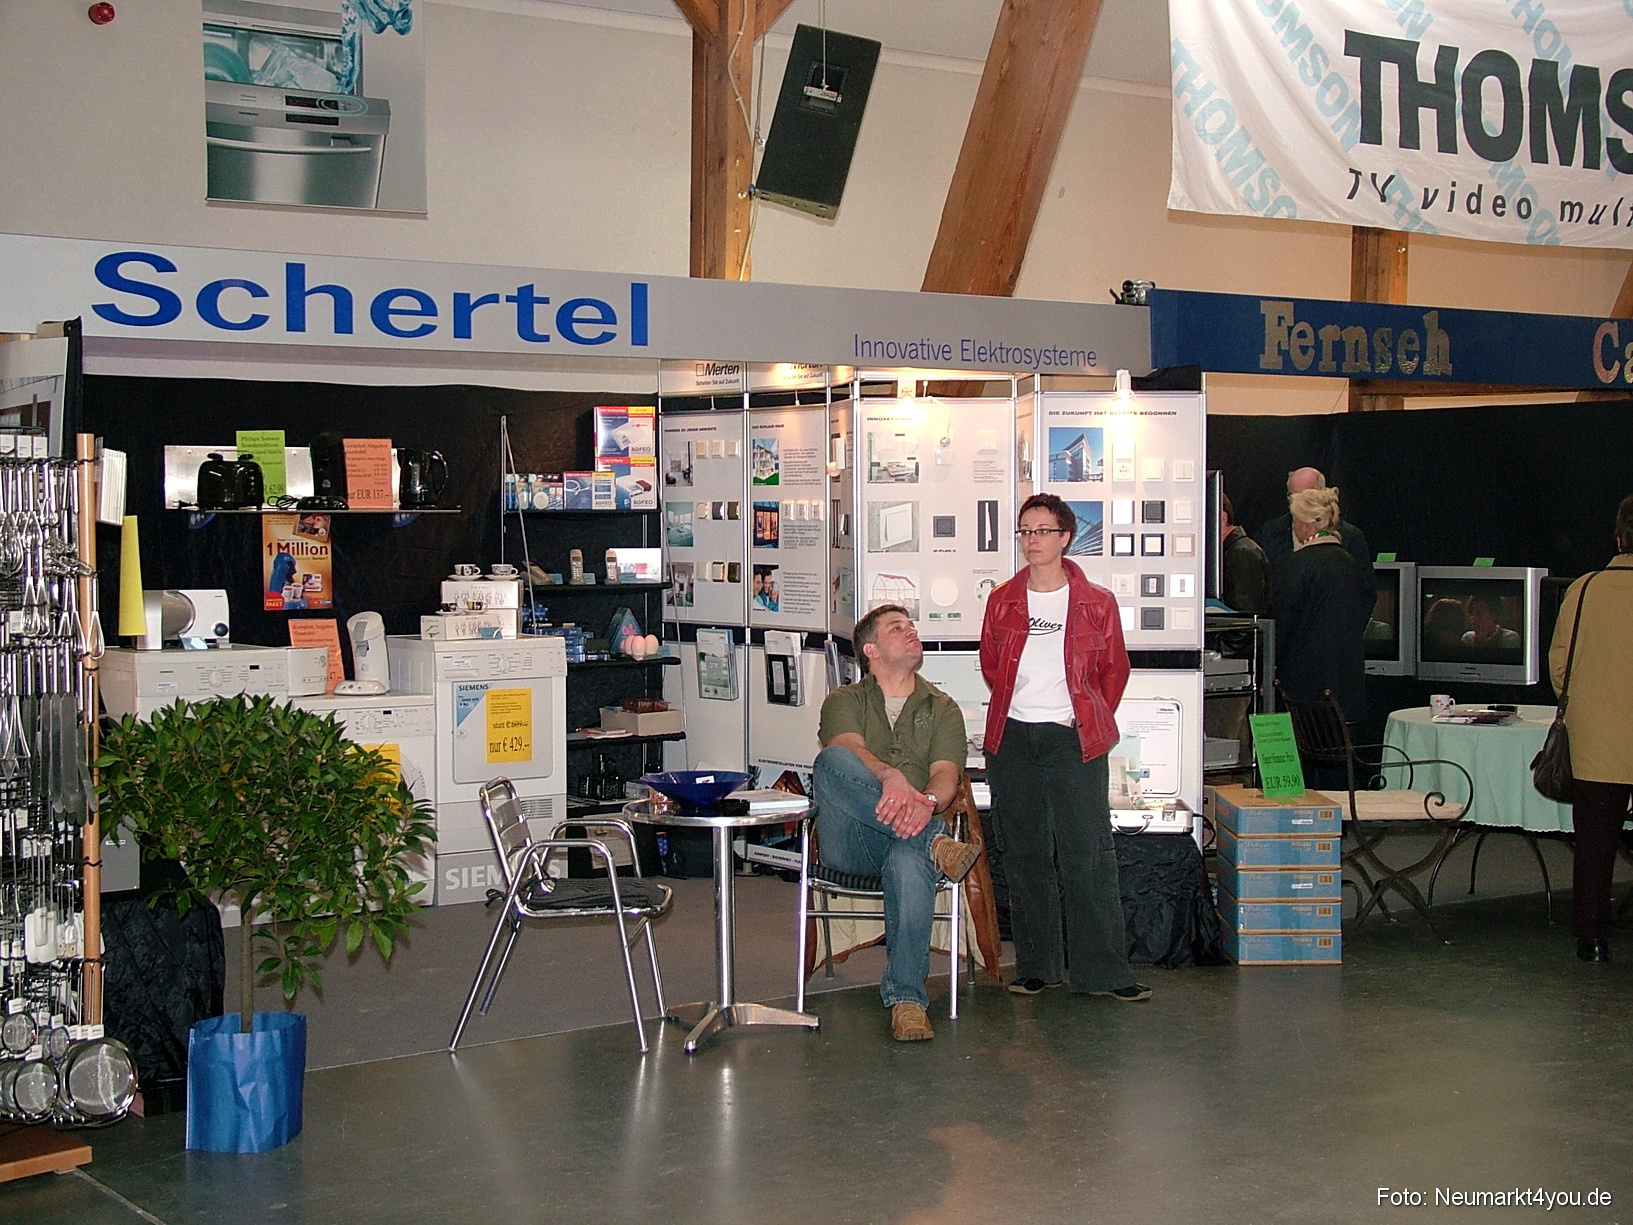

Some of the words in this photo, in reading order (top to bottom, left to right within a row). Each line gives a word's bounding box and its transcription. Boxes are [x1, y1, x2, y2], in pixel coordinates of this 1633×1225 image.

[1347, 168, 1396, 202] TV
[1421, 181, 1532, 219] video
[91, 251, 648, 347] Schertel
[1260, 300, 1453, 376] Fernseh
[854, 334, 952, 361] Innovative
[960, 339, 1097, 369] Elektrosysteme
[704, 363, 740, 376] Merten
[356, 489, 371, 499] EUR
[267, 542, 273, 556] 1
[277, 541, 329, 556] Million
[1029, 617, 1063, 630] Oliver
[458, 683, 489, 691] SIEMENS
[489, 742, 501, 753] nur
[502, 737, 508, 753] €
[1265, 776, 1282, 790] EUR
